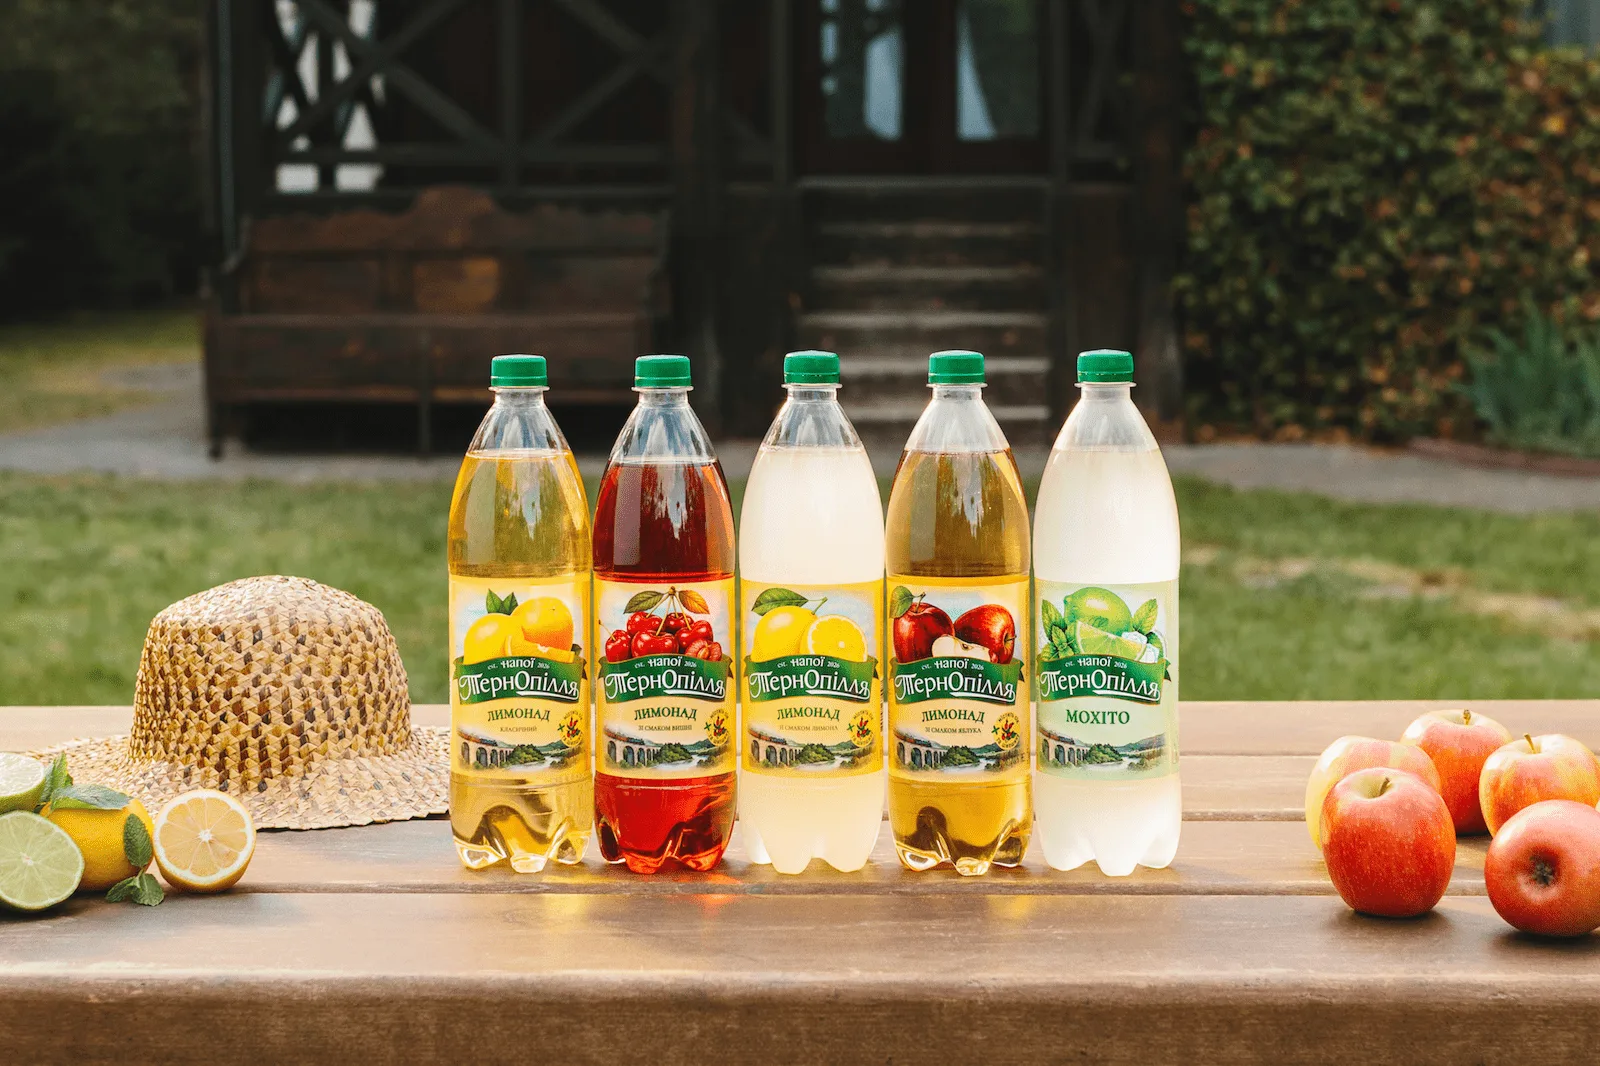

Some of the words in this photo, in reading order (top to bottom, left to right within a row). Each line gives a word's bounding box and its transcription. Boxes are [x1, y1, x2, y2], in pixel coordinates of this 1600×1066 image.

[488, 708, 550, 722] ЛИМОНАД
[634, 706, 697, 721] ЛИМОНАД
[777, 707, 840, 721] ЛИМОНАД
[922, 709, 985, 723] ЛИМОНАД
[1066, 710, 1130, 724] МОХІТО
